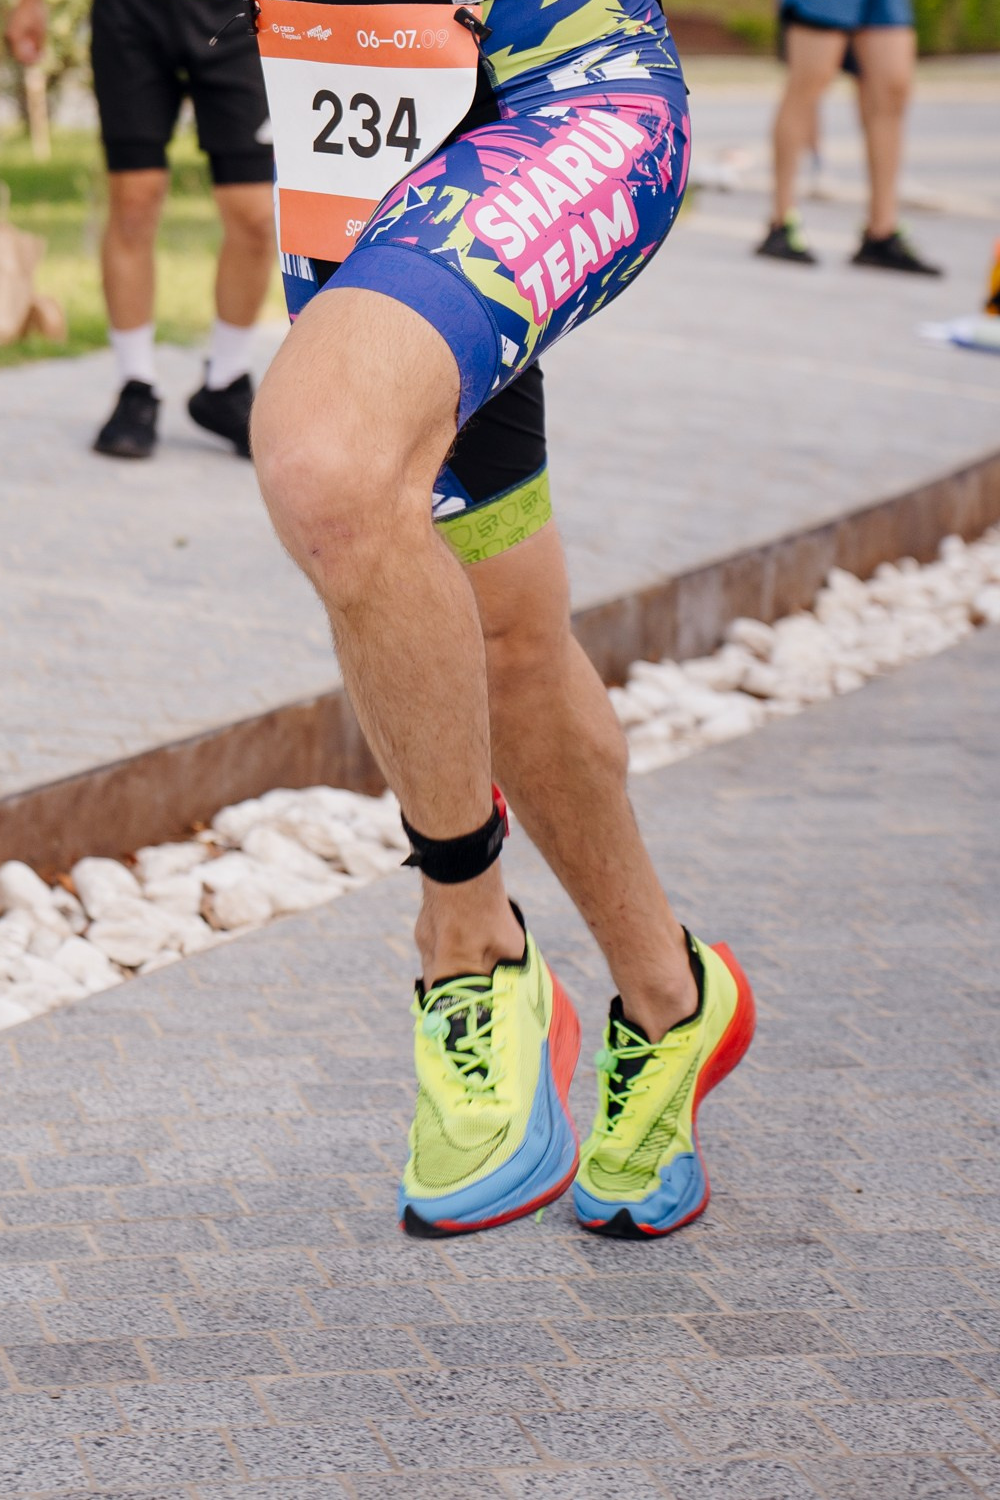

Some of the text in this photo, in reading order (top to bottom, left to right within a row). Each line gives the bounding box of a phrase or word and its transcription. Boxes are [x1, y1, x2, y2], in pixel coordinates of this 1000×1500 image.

[312, 88, 422, 163] 234
[474, 109, 645, 261] SHARUN
[519, 189, 635, 318] TEAM
